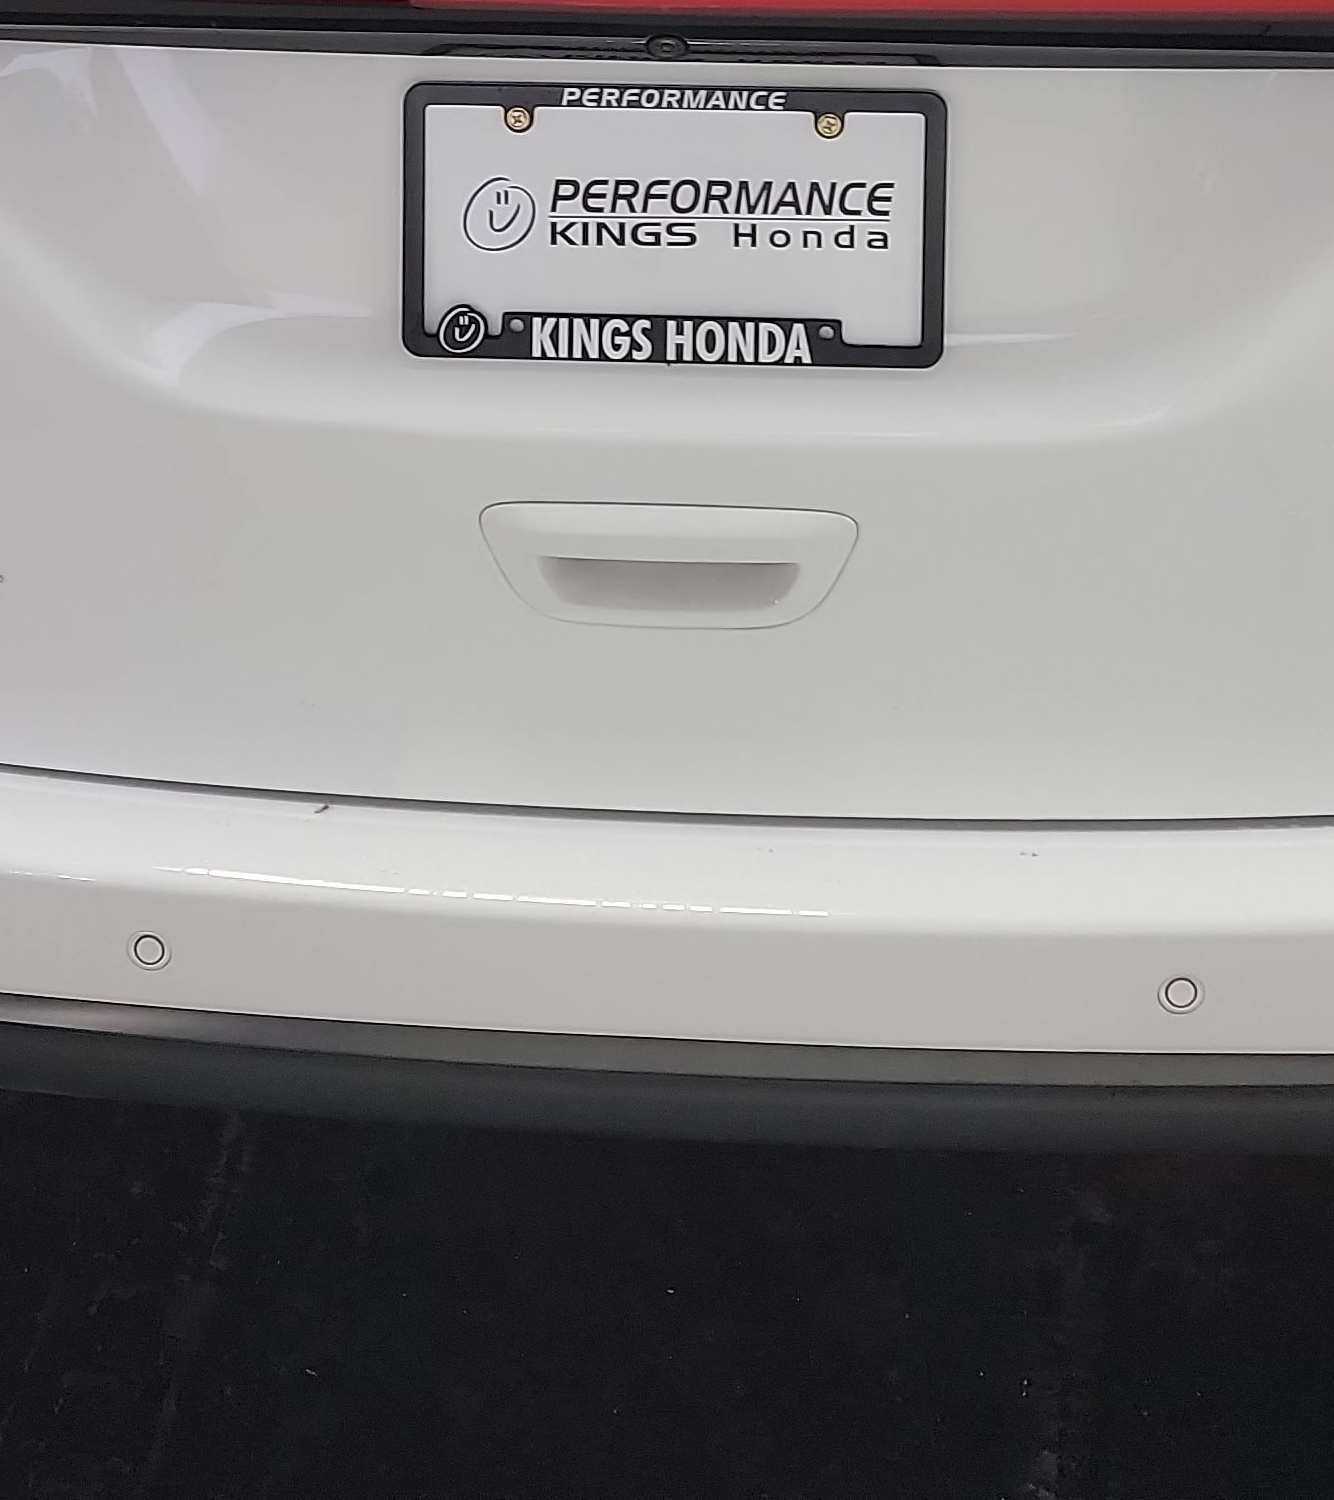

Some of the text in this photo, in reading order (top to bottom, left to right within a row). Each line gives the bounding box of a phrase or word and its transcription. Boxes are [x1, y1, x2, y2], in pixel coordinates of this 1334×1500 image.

[561, 87, 787, 111] PERFORMANCE
[550, 178, 895, 216] PERFORMANCE
[549, 221, 890, 250] KINGS Honda
[531, 317, 813, 365] KINGS HONDA
